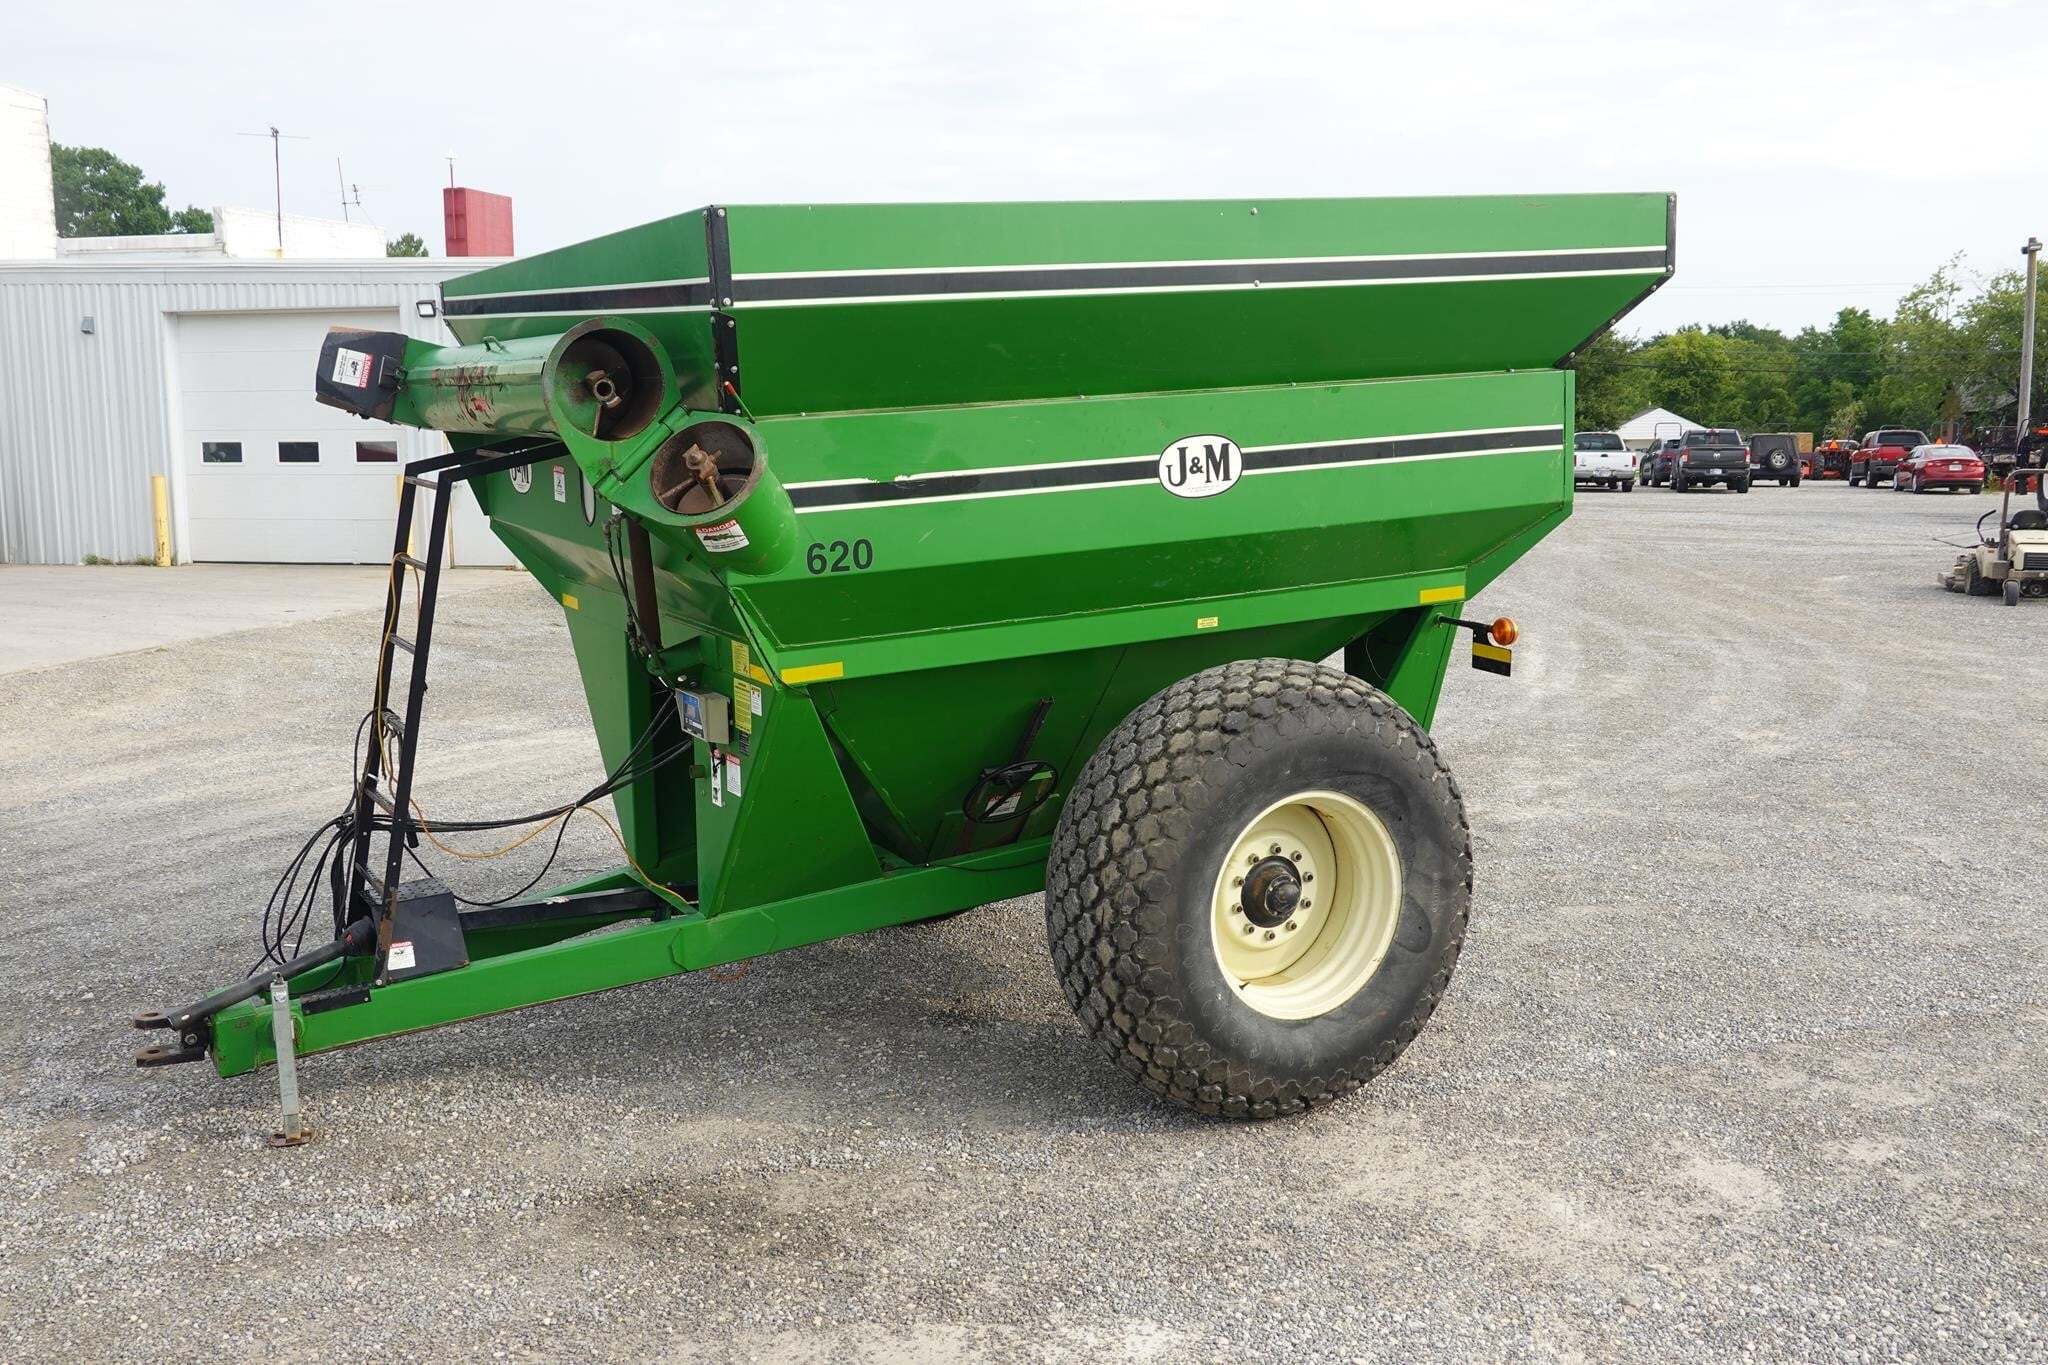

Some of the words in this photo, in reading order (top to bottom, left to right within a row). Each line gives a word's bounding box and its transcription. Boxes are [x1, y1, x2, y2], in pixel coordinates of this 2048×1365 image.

[1166, 443, 1232, 487] J&M
[702, 520, 737, 534] DANGER
[806, 538, 873, 575] 620
